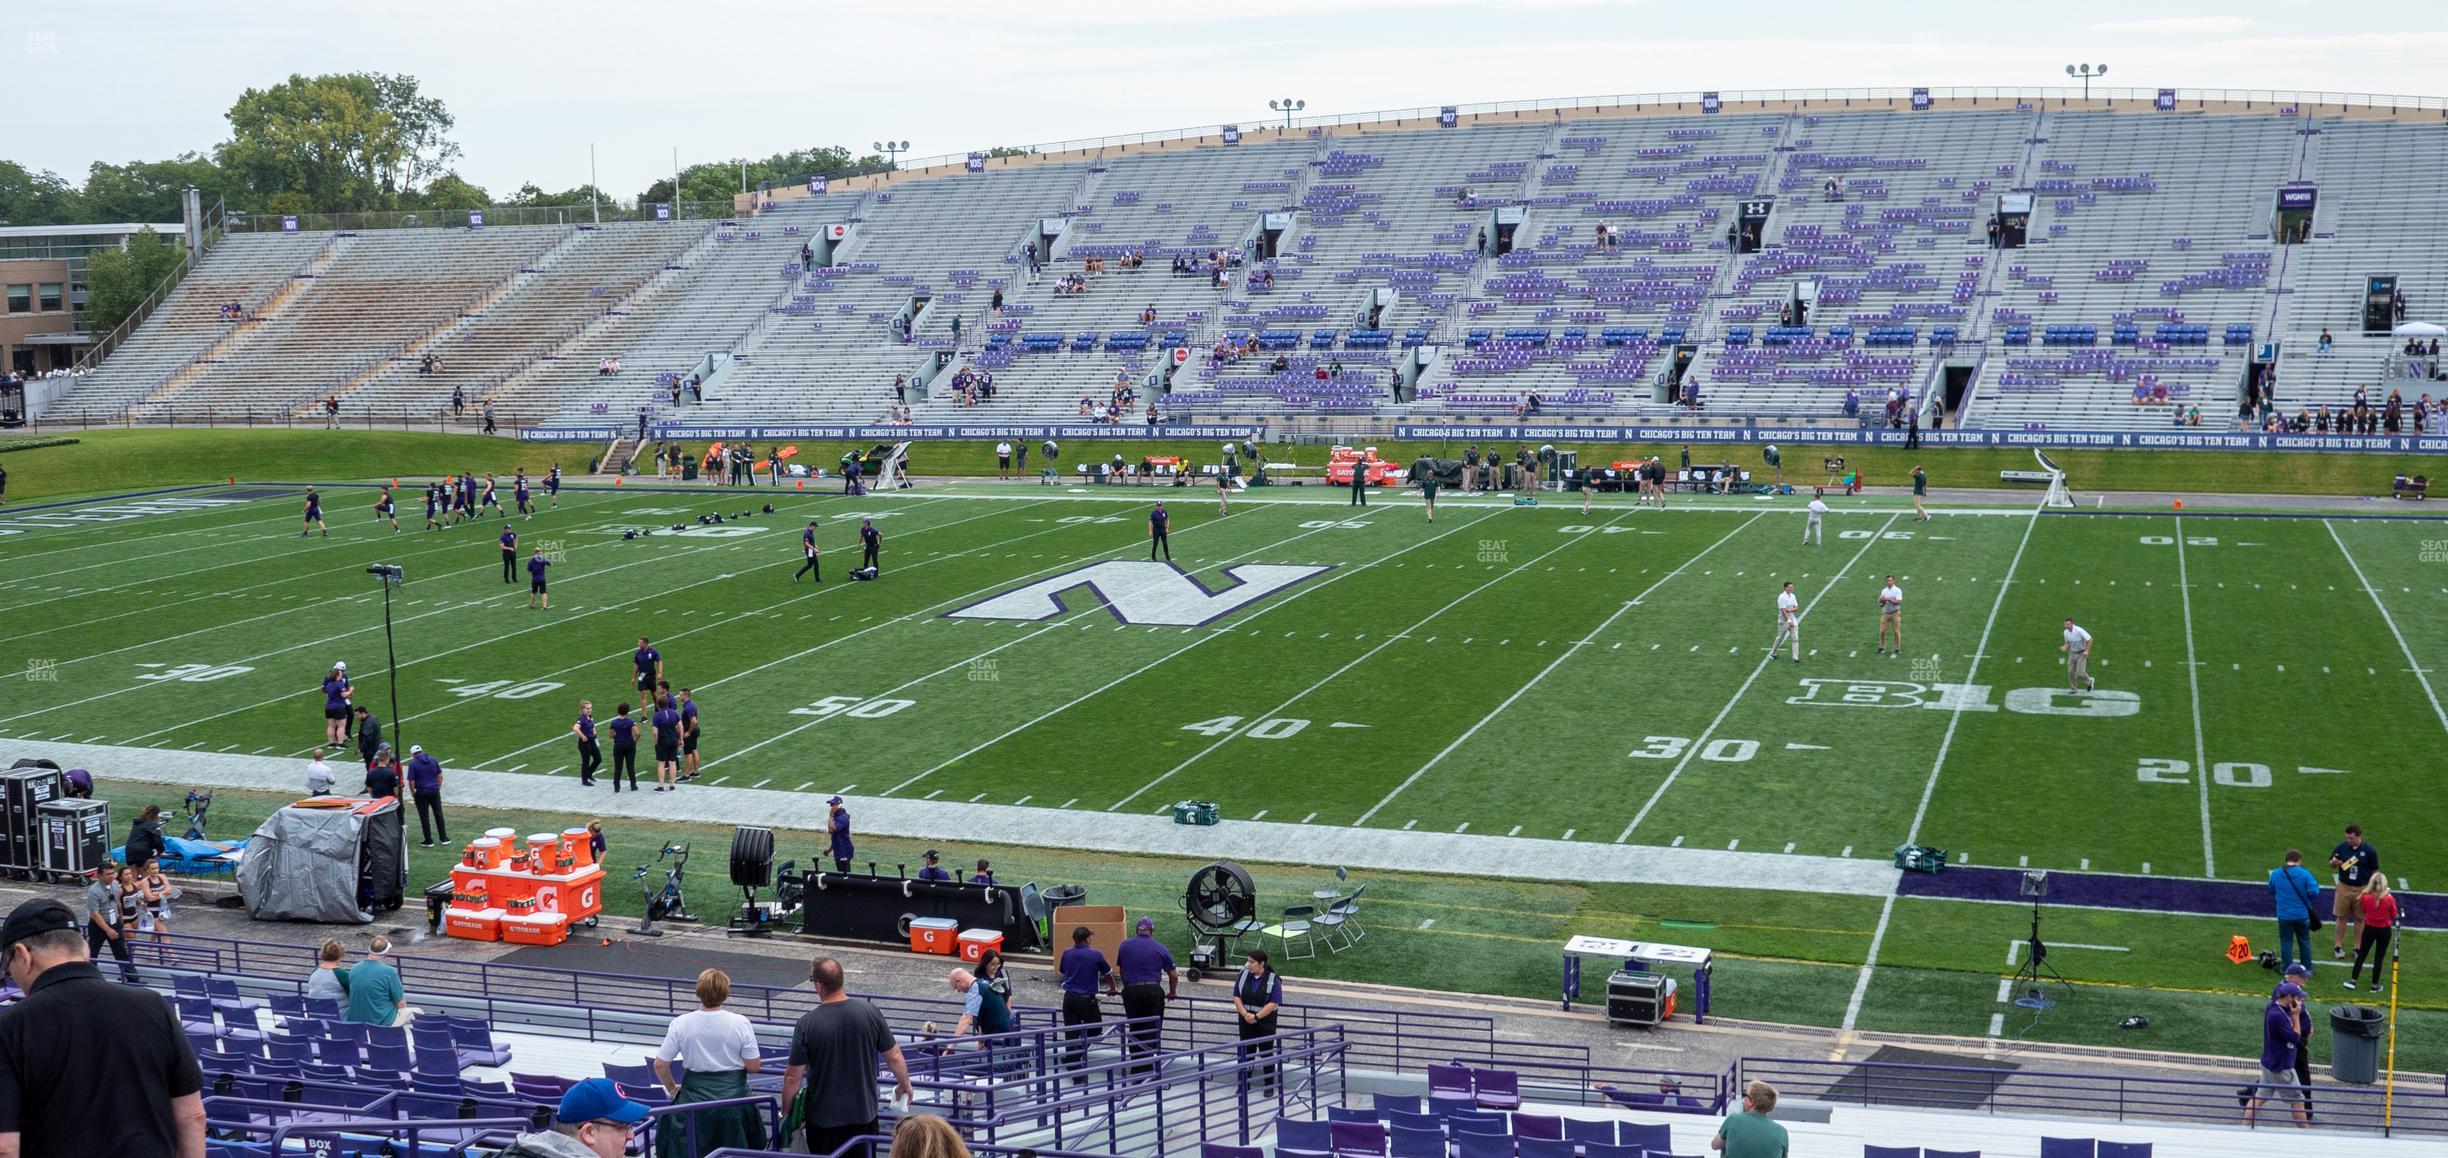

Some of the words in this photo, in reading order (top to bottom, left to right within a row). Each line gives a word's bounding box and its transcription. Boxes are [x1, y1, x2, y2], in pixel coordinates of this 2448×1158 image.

[1704, 98, 1717, 107] 108
[1914, 94, 1927, 104] 109
[2160, 95, 2172, 105] 110
[1443, 113, 1454, 122] 107
[1225, 131, 1237, 140] 106
[969, 159, 982, 168] 105
[812, 181, 825, 190] 104
[657, 209, 668, 218] 103
[285, 220, 296, 229] 101
[470, 215, 482, 224] 102
[522, 431, 529, 439] N
[530, 431, 564, 439] CHICAGO'S
[564, 431, 576, 439] BIG
[610, 430, 616, 439] N
[655, 430, 661, 438] N
[751, 429, 758, 438] N
[763, 429, 797, 437] CHICAGO'S
[849, 428, 855, 437] N
[861, 429, 895, 437] CHICAGO'S
[909, 429, 923, 437] TEN
[924, 428, 942, 436] TEAM
[948, 427, 955, 436] N
[960, 428, 996, 436] CHICAGO'S
[996, 428, 1008, 436] BIG
[1010, 428, 1024, 436] TEN
[1024, 428, 1044, 436] TEAM
[1050, 427, 1056, 436] N
[1062, 428, 1098, 436] CHICAGO'S
[1098, 428, 1110, 436] BIG
[1112, 428, 1126, 436] TEN
[1127, 428, 1146, 436] TEAM
[1152, 427, 1159, 437] N
[1165, 428, 1201, 436] CHICAGO'S
[1202, 428, 1214, 436] BIG
[1216, 428, 1230, 436] TEN
[1231, 428, 1251, 436] TEAM
[1398, 427, 1406, 437] N
[1412, 428, 1450, 437] CHICAGO'S
[1451, 428, 1464, 437] BIG
[1466, 429, 1481, 437] TEN
[1482, 429, 1503, 437] TEAM
[1510, 428, 1517, 438] N
[1524, 429, 1563, 437] CHICAGO'S
[1564, 429, 1578, 438] BIG
[1579, 429, 1595, 438] TEN
[1596, 430, 1618, 438] TEAM
[1625, 429, 1632, 439] N
[1640, 430, 1680, 439] CHICAGO'S
[1681, 430, 1694, 439] BIG
[1696, 430, 1712, 439] TEN
[1713, 431, 1735, 439] TEAM
[1743, 430, 1751, 440] N
[1758, 431, 1800, 440] CHICAGO'S
[1801, 432, 1815, 440] BIG
[1816, 432, 1833, 440] TEN
[1834, 432, 1857, 441] TEAM
[1865, 432, 1873, 442] N
[1925, 433, 1939, 442] BIG
[1941, 433, 1958, 442] TEN
[1960, 433, 1983, 442] TEAM
[1992, 433, 2000, 443] N
[2008, 434, 2052, 443] CHICAGO'S
[2054, 434, 2068, 443] BIG
[2070, 434, 2088, 443] TEN
[2089, 435, 2114, 444] TEAM
[2122, 434, 2130, 445] N
[2139, 436, 2185, 445] CHICAGO'S
[2187, 436, 2202, 446] BIG
[2204, 436, 2222, 445] TEN
[2224, 437, 2250, 446] TEAM
[2259, 436, 2267, 447] N
[2276, 438, 2324, 447] CHICAGO'S
[2326, 438, 2341, 447] BIG
[2344, 439, 2362, 448] TEN
[2365, 439, 2391, 448] TEAM
[2401, 438, 2409, 449] N
[937, 560, 1338, 627] N
[134, 663, 255, 682] 30
[445, 680, 566, 699] 40
[787, 696, 917, 718] 50
[1180, 715, 1312, 739] 40
[1628, 735, 1761, 762] 30
[2136, 757, 2273, 788] 20
[476, 851, 484, 860] G
[531, 847, 540, 859] G
[536, 886, 558, 913] G
[581, 887, 593, 909] G
[924, 931, 934, 942] G
[967, 944, 979, 959] G
[2238, 943, 2249, 959] 20
[309, 1139, 332, 1150] BOX
